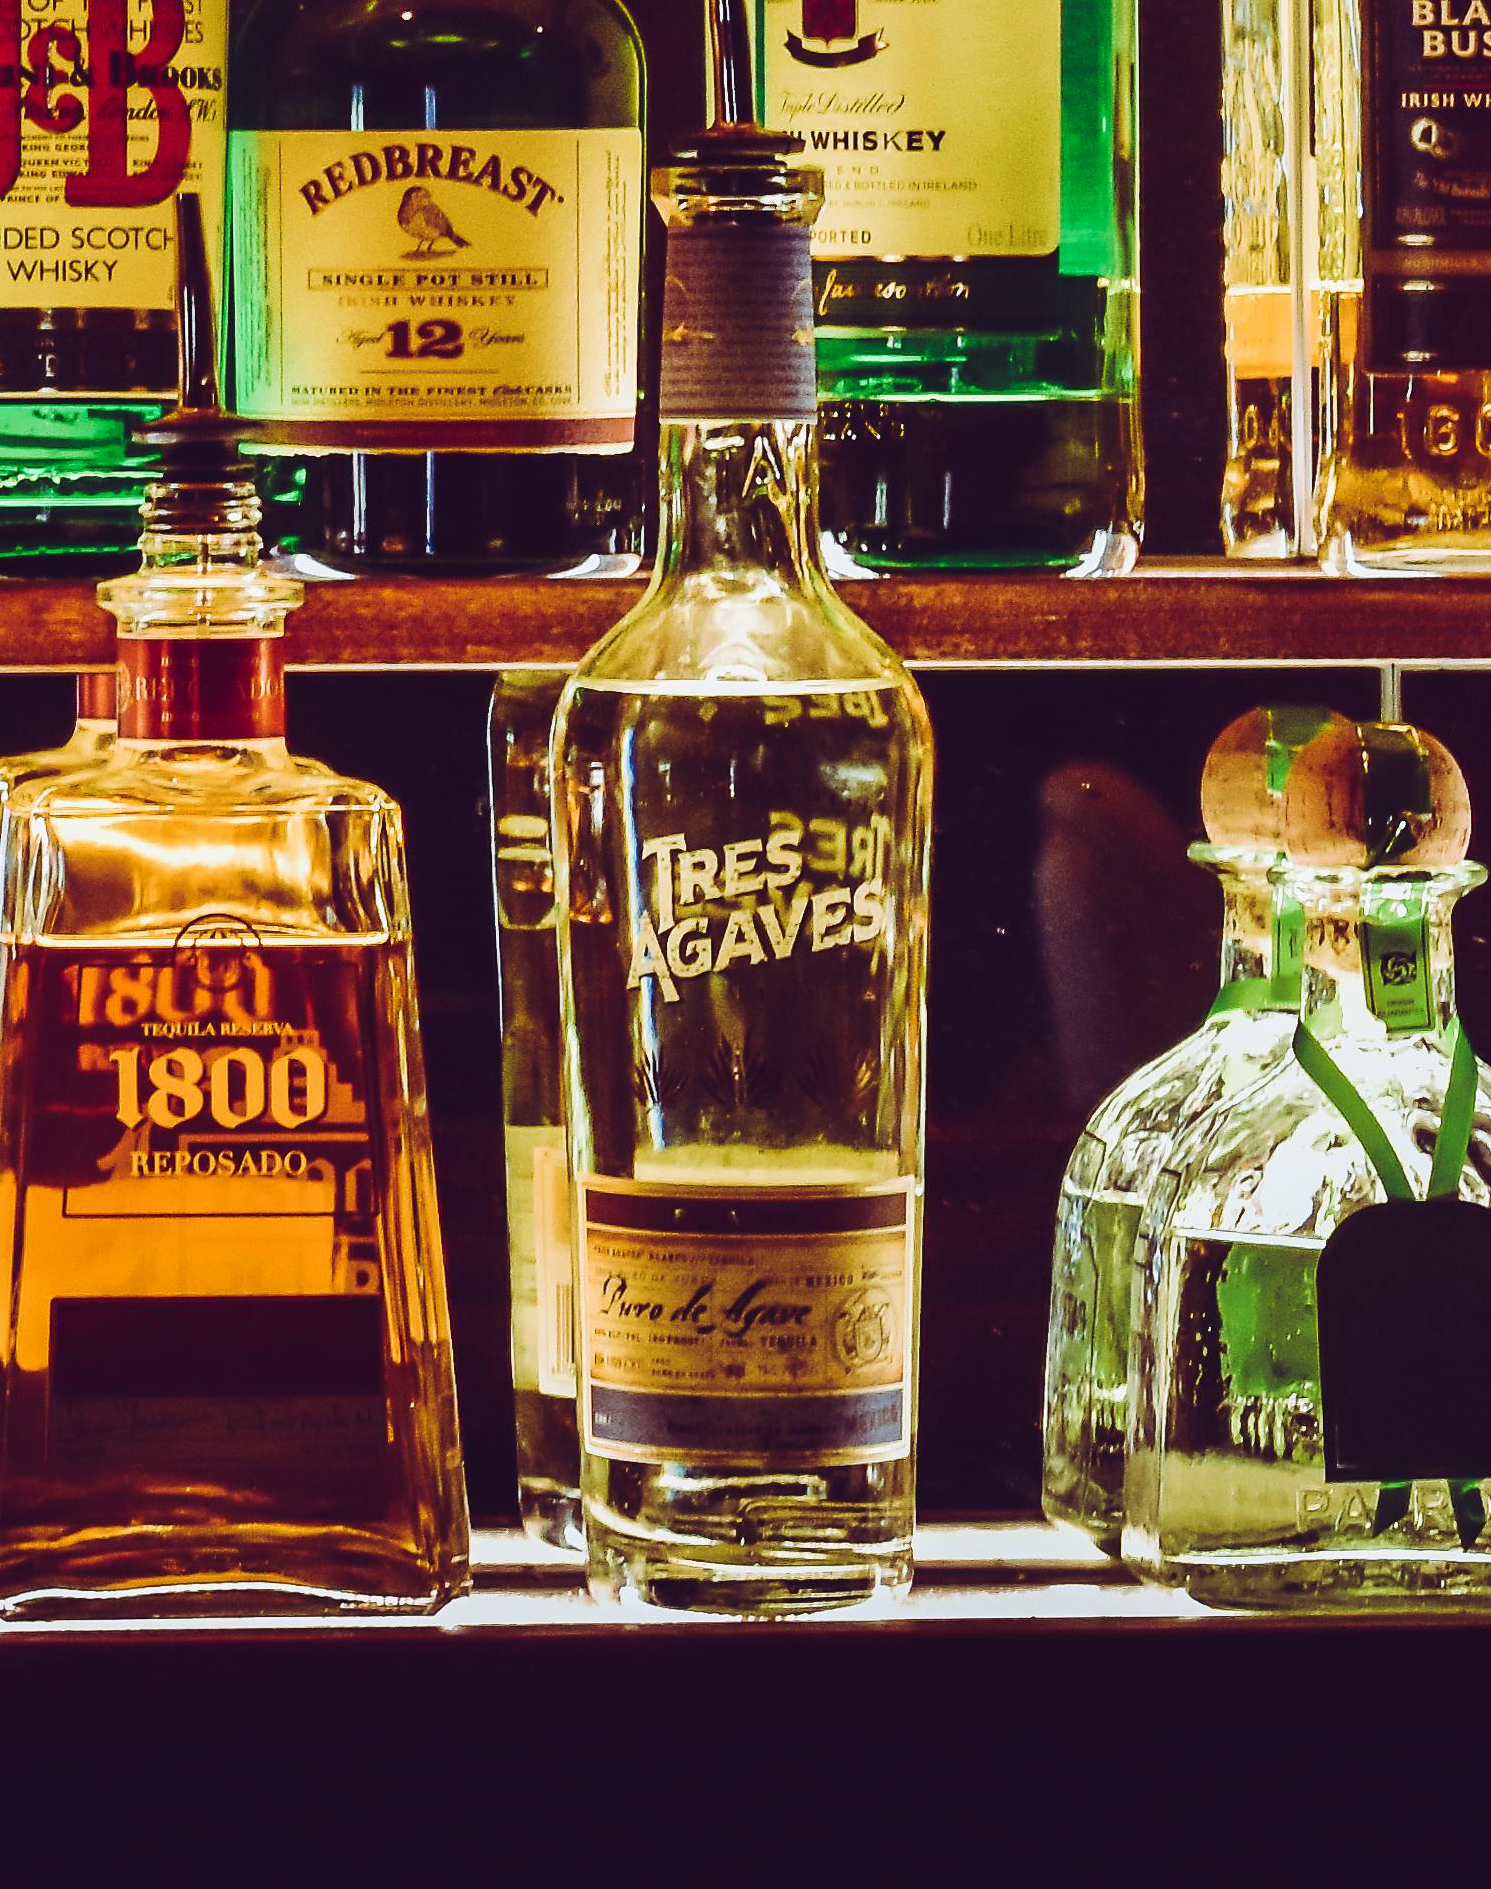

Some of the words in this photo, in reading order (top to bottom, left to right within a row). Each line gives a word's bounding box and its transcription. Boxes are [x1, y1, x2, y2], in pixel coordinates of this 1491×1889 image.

[1401, 91, 1456, 110] IRISH
[811, 129, 946, 152] WHISKEY
[299, 143, 555, 217] REDBREAST
[72, 228, 174, 249] SCOTCH
[8, 260, 118, 283] WHISKY
[322, 274, 405, 287] SINGLE
[416, 274, 457, 287] POT
[471, 274, 538, 285] STILL
[337, 296, 398, 307] IRISH
[409, 296, 515, 307] WHISKEY
[386, 318, 464, 359] 12
[642, 831, 801, 933] TRES
[626, 879, 887, 1002] AGAVES
[141, 1022, 215, 1036] TEQUILA
[220, 1022, 292, 1036] RESERVA
[110, 1046, 325, 1129] 1800
[130, 1150, 306, 1176] REPOSADO
[670, 1283, 716, 1334] de
